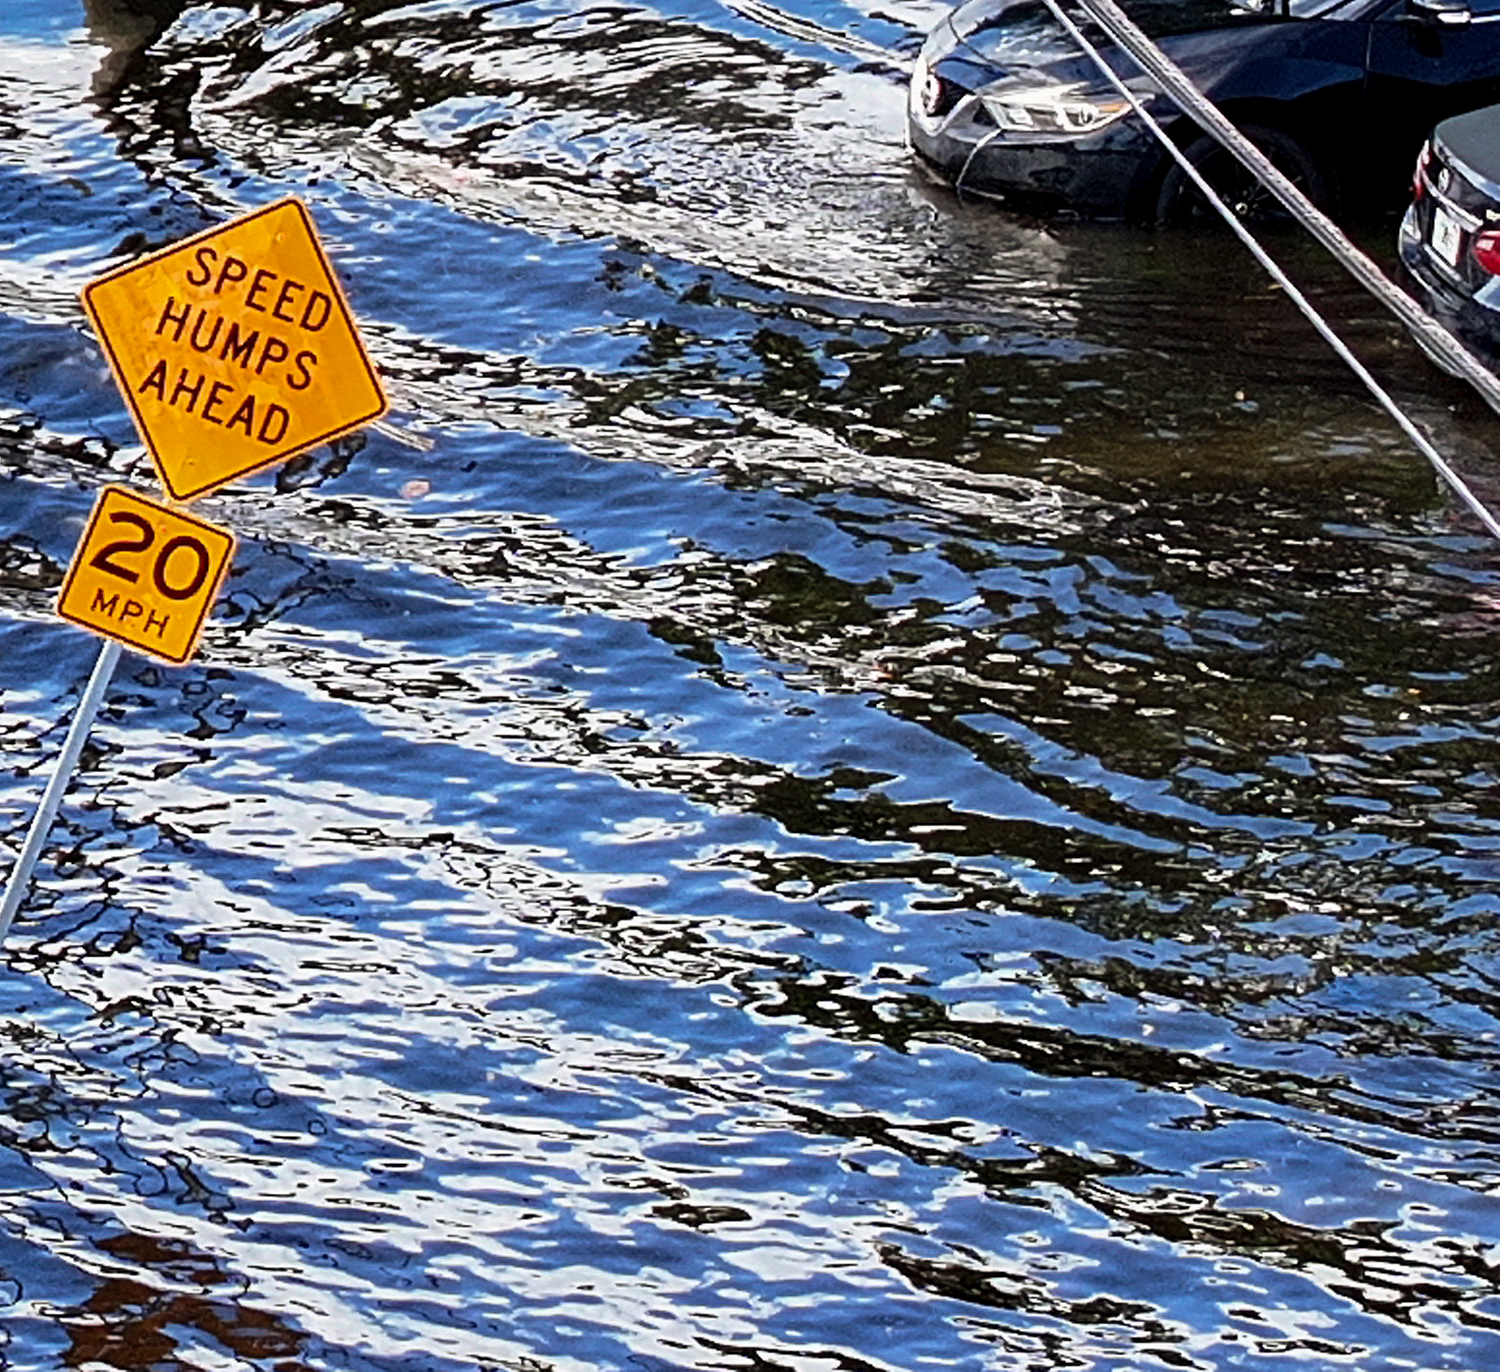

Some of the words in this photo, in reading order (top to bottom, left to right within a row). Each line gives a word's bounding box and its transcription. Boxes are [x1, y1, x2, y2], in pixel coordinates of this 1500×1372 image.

[186, 247, 333, 332] SPEED
[155, 296, 318, 391] HUMPS
[139, 359, 291, 445] AHEAD
[89, 512, 210, 601] 20
[90, 588, 171, 639] MPH
